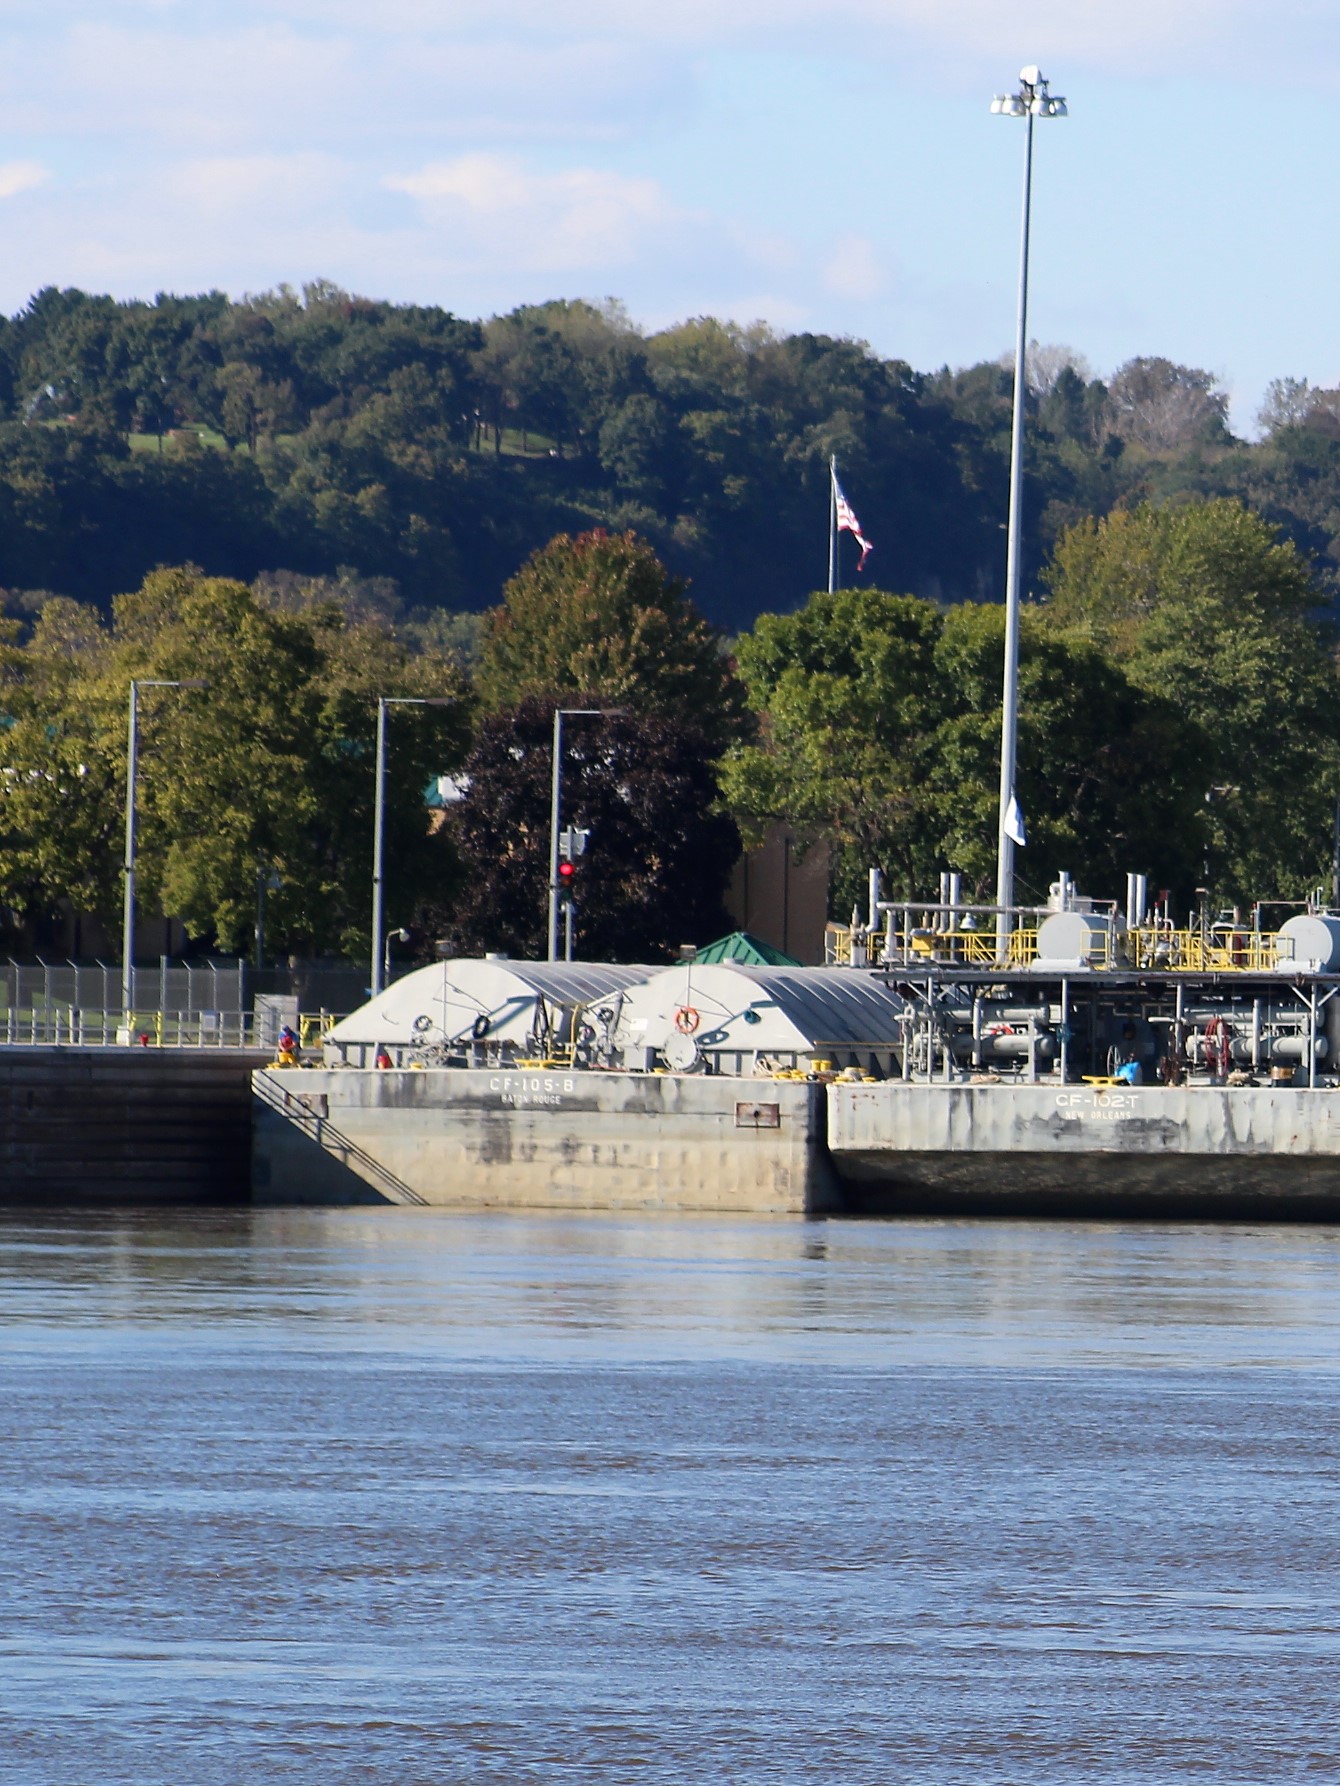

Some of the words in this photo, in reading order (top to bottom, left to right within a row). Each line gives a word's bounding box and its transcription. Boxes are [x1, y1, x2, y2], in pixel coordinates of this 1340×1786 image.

[489, 1078, 574, 1092] CF-105-B
[501, 1094, 528, 1103] BATON
[533, 1095, 561, 1104] ROUGE
[1055, 1094, 1139, 1108] CF-102-T
[1065, 1111, 1084, 1120] NEW
[1090, 1111, 1131, 1120] ORLEANS
